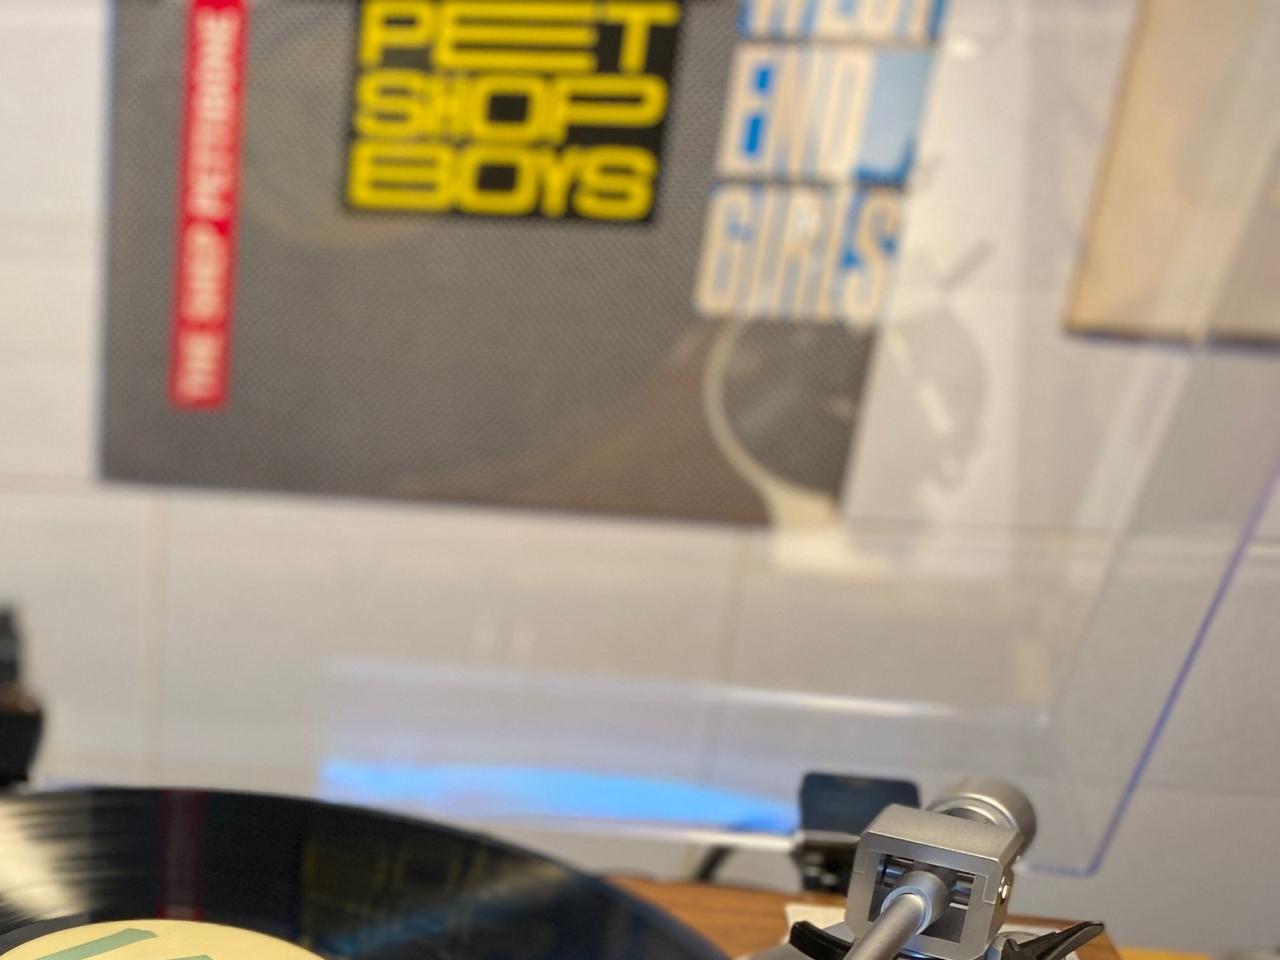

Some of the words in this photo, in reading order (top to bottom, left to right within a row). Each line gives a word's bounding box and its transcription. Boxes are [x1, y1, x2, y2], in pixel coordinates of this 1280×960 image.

[360, 0, 682, 74] PET
[354, 68, 669, 146] SHOP
[348, 140, 658, 221] BOYS
[696, 184, 904, 332] GIRLS
